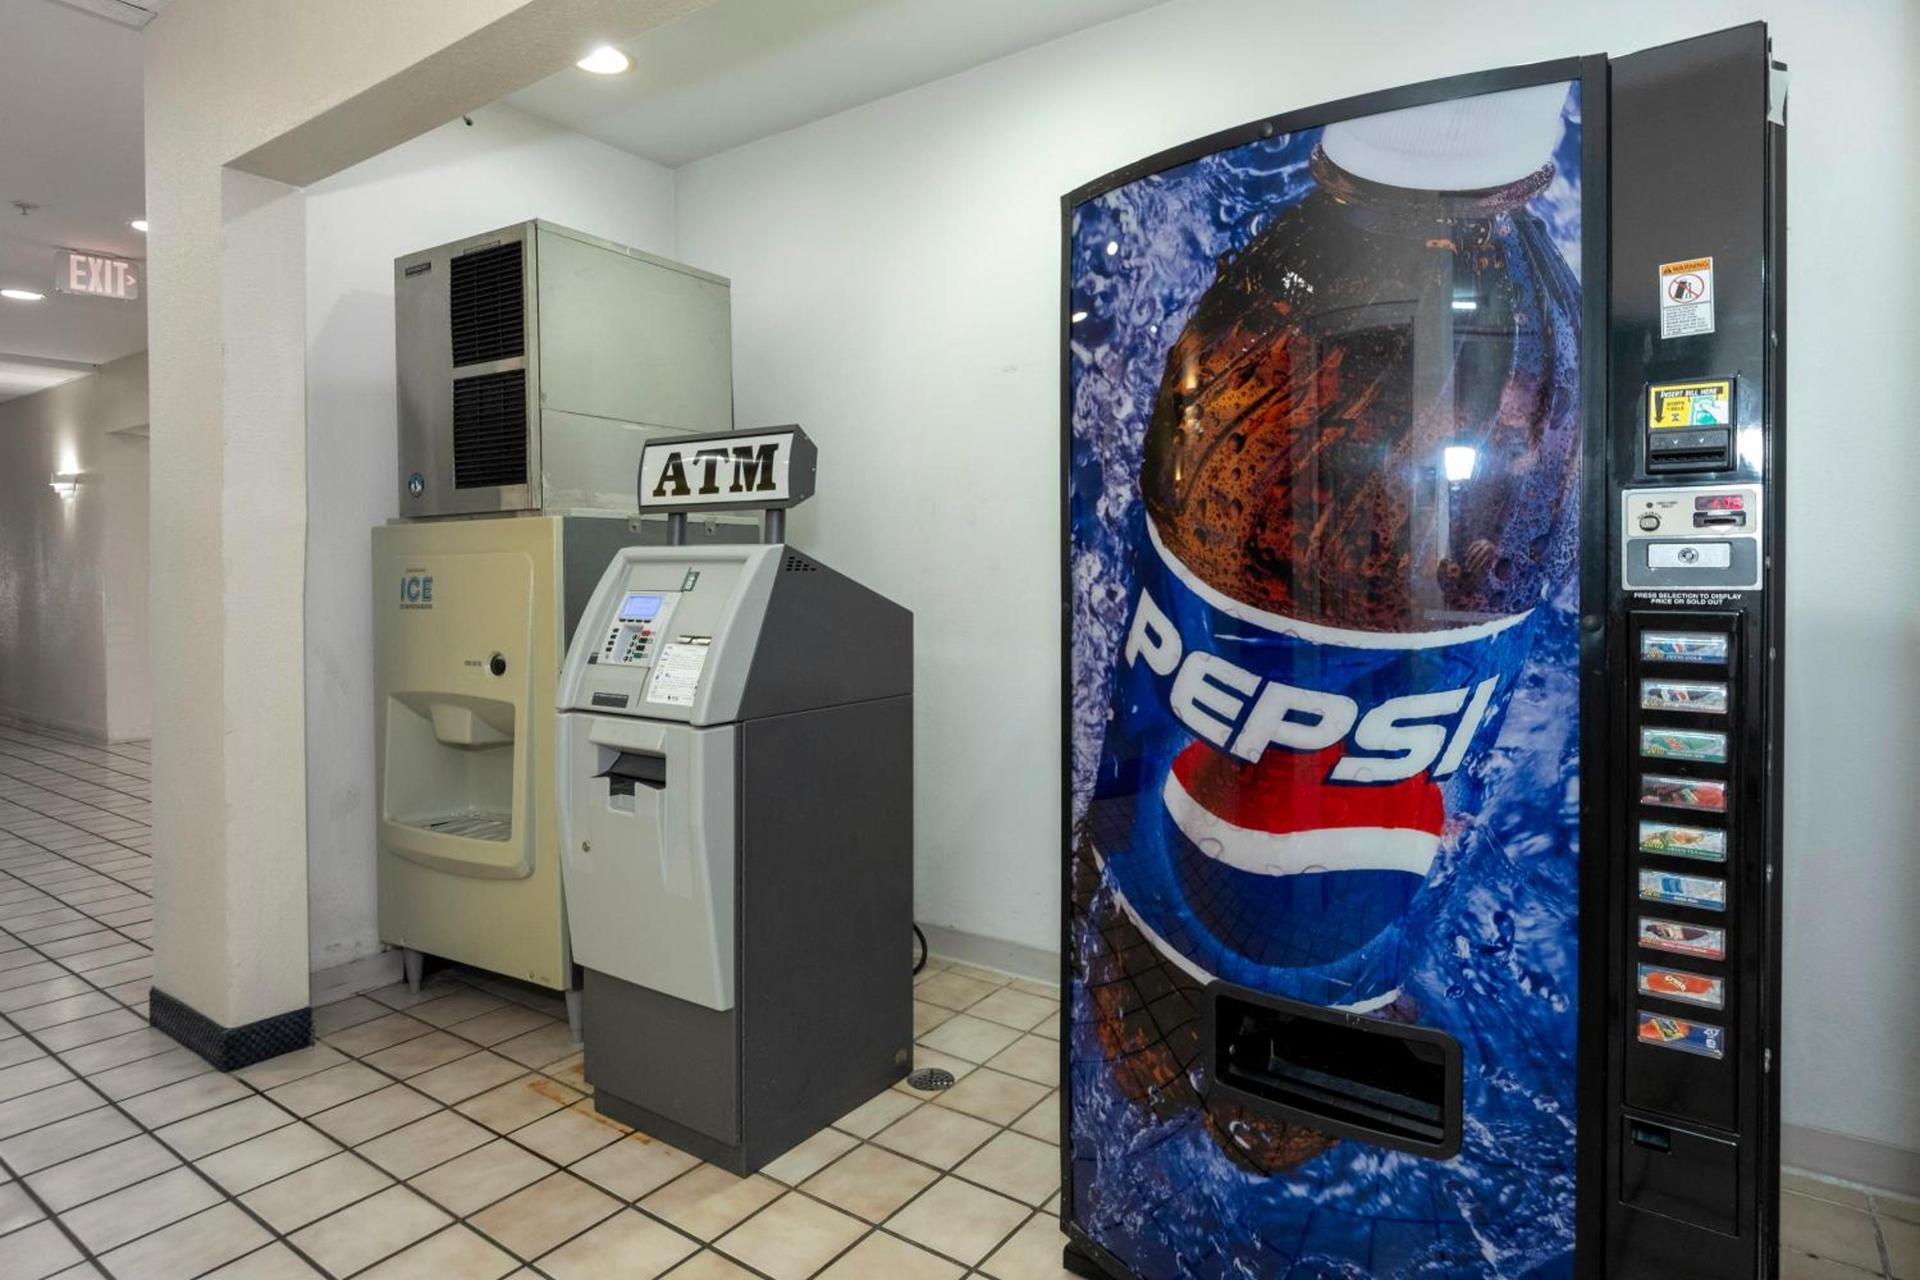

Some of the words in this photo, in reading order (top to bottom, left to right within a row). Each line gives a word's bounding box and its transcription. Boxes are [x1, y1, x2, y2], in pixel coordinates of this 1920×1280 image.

[70, 254, 129, 297] EXIT
[1673, 261, 1709, 272] WARNING
[653, 443, 779, 497] ATM
[400, 576, 433, 602] ICE
[1125, 587, 1500, 782] PEPSI
